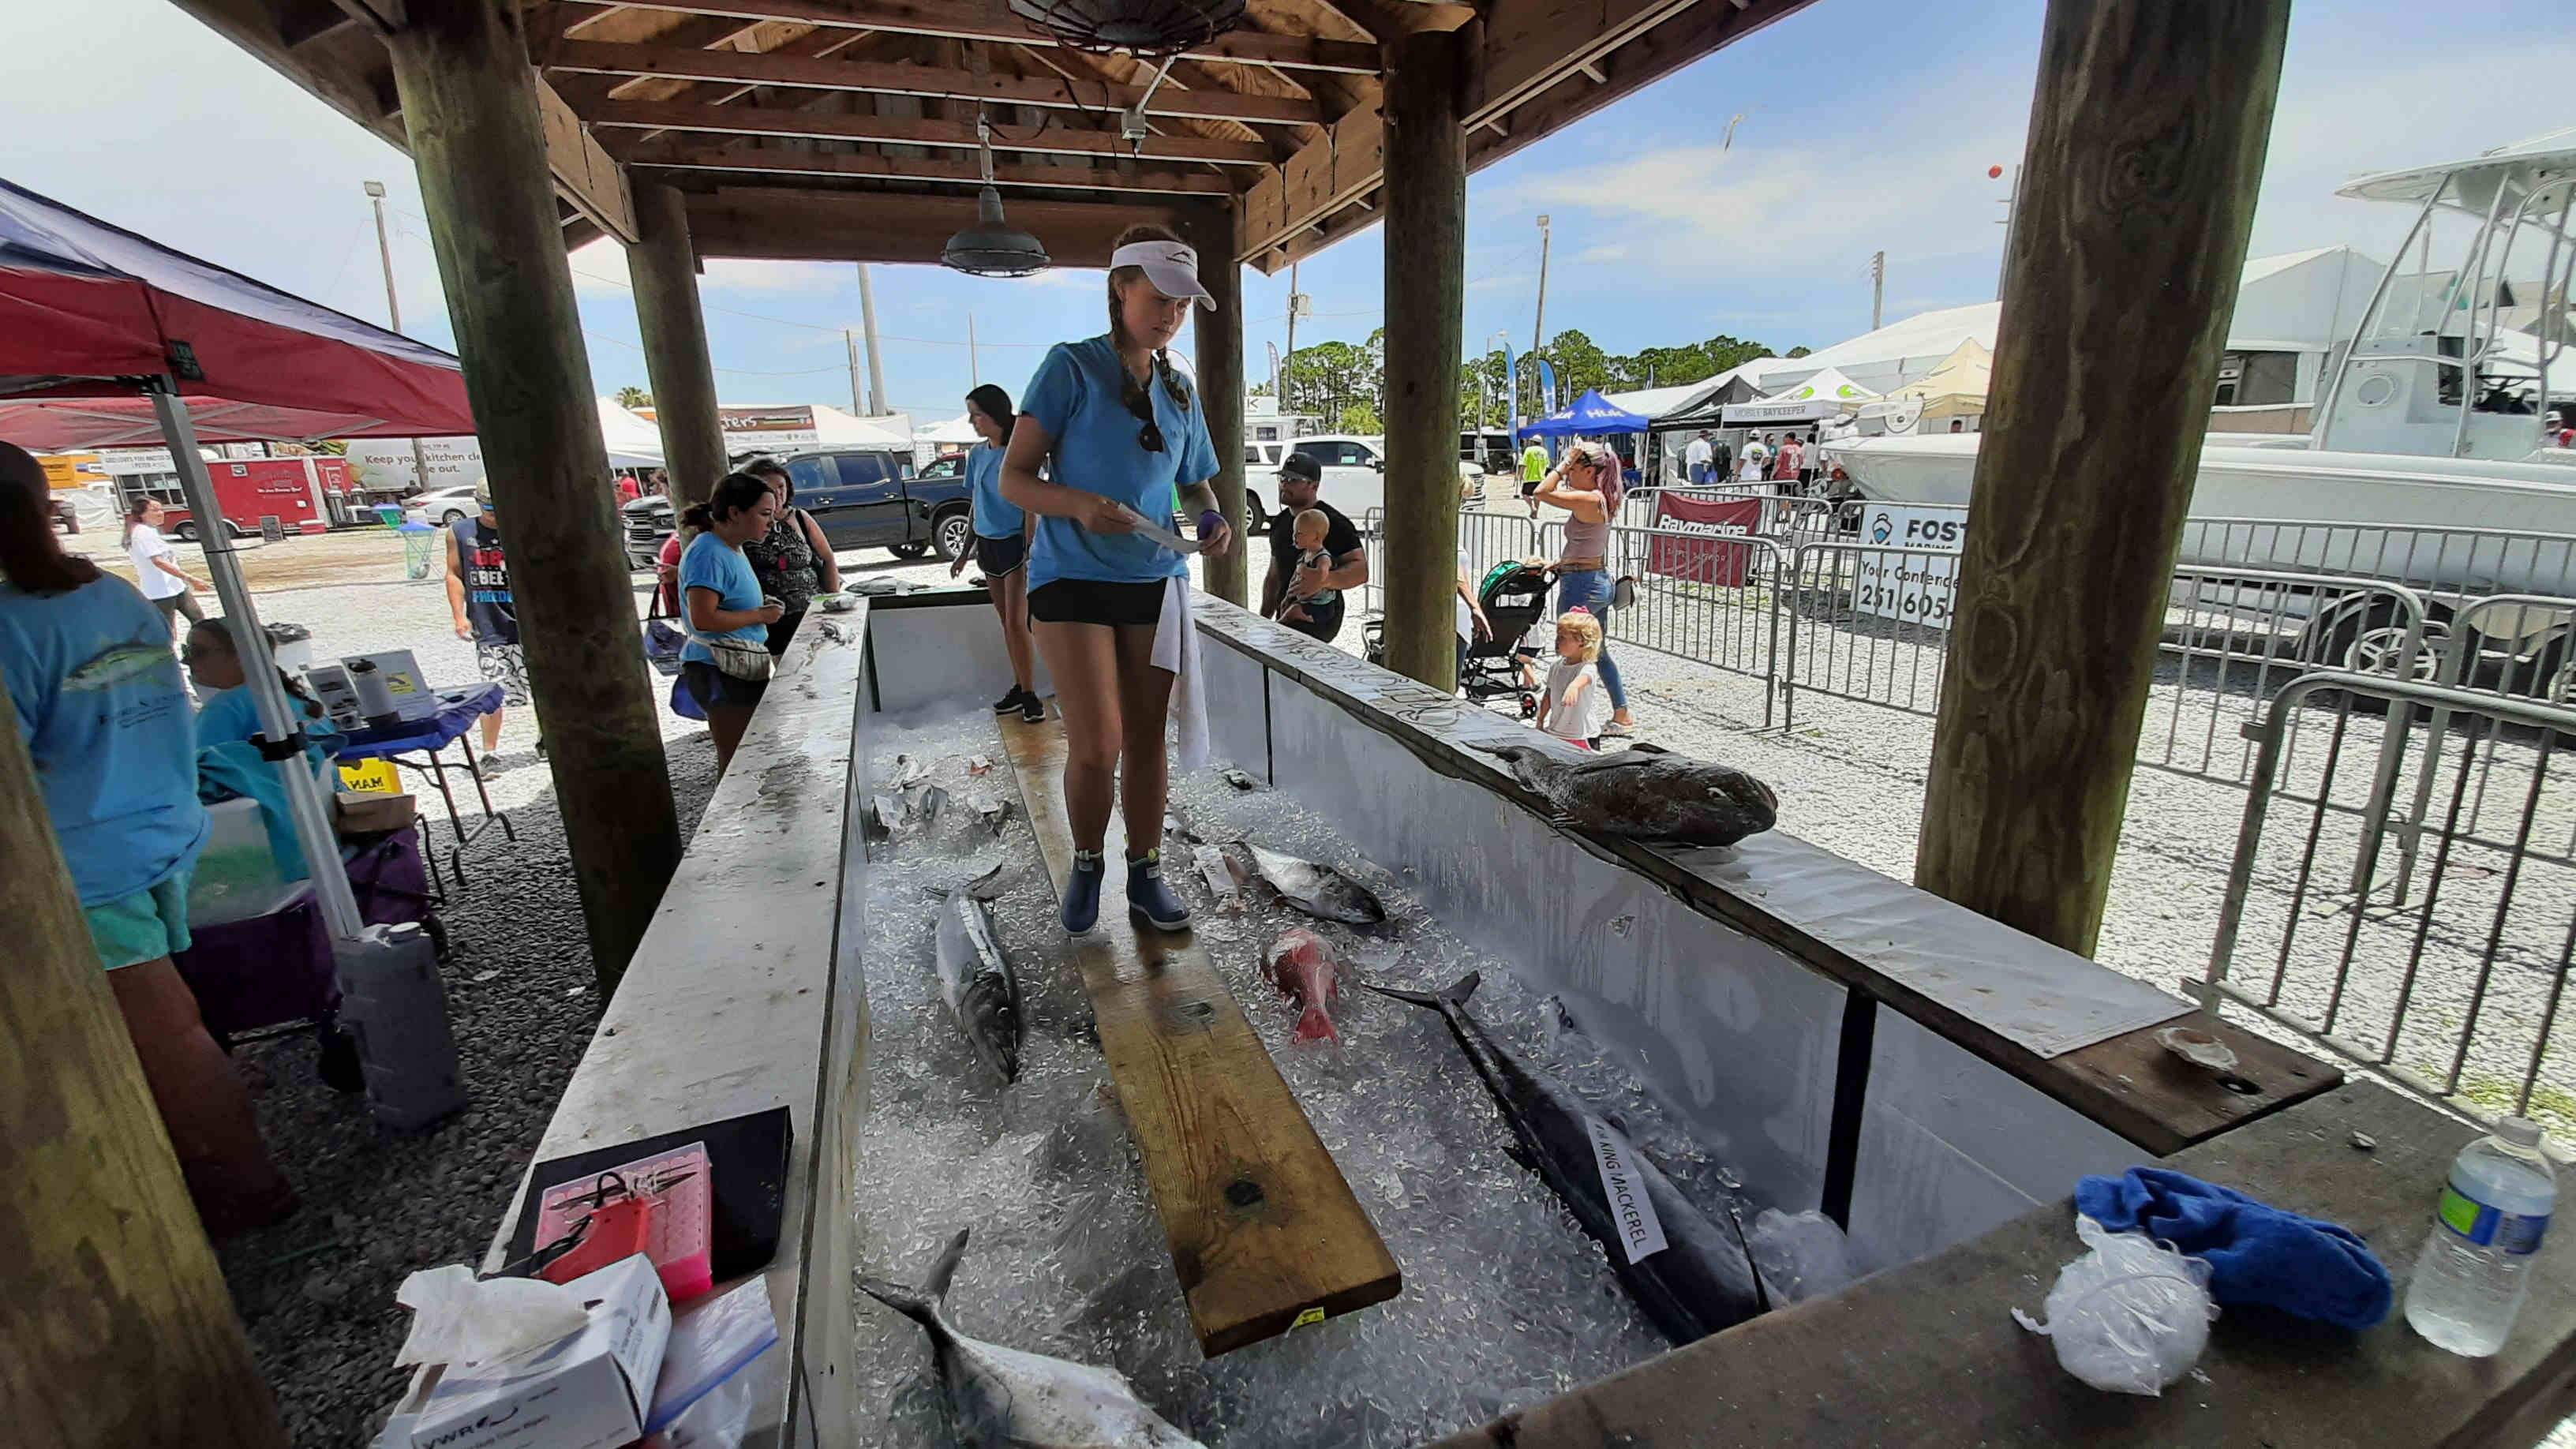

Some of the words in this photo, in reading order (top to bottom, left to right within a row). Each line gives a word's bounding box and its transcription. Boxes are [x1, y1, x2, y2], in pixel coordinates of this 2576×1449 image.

[1763, 406, 1806, 416] BAYKEEPER
[365, 455, 394, 465] Keep
[398, 455, 418, 466] you
[425, 451, 465, 462] kitchen
[1658, 513, 1748, 537] Raymarine
[1862, 561, 1889, 578] Your
[1600, 1142, 1620, 1169] KING
[1610, 1173, 1648, 1249] MACKEREL
